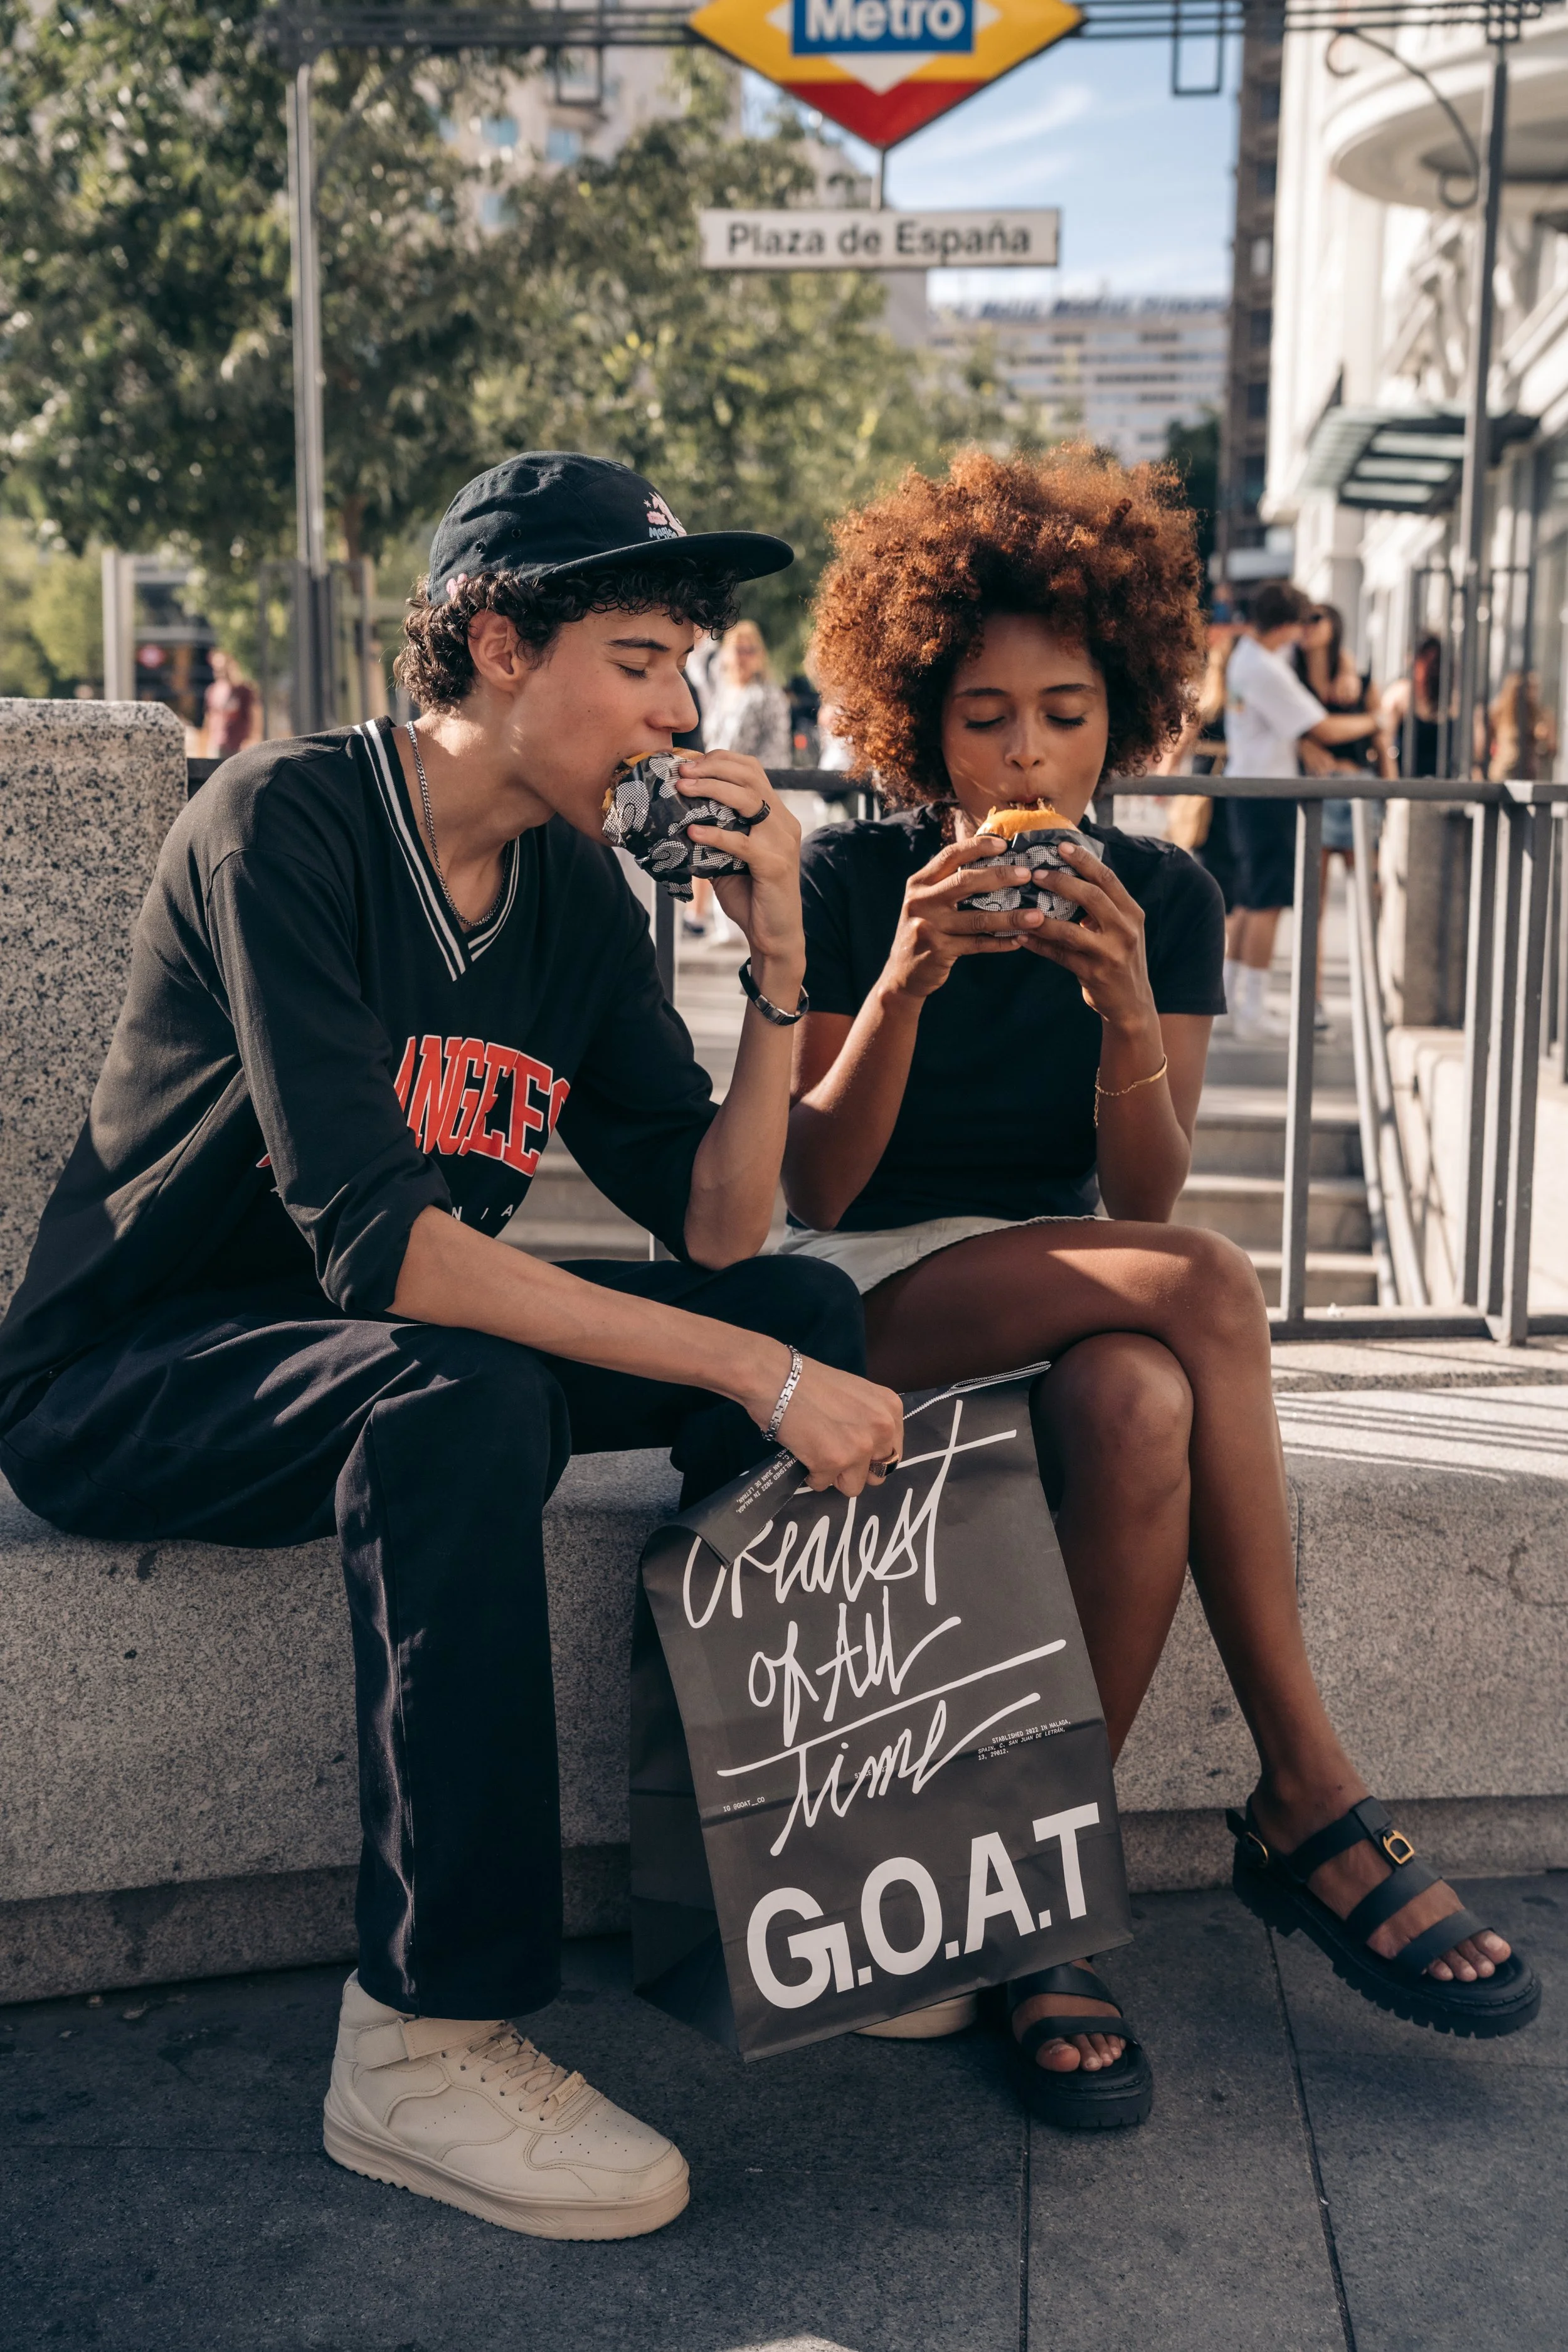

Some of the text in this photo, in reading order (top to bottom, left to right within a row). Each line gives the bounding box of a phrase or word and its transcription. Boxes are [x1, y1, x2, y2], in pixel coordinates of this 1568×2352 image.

[805, 0, 967, 41] Metro
[727, 218, 1030, 260] Plaza de España
[761, 1469, 773, 1481] JUAN
[773, 1461, 783, 1471] SAN
[773, 1456, 798, 1481] TABLISHED
[755, 1480, 762, 1488] DE
[762, 1479, 773, 1491] 2022
[748, 1586, 961, 1747] of All
[992, 1730, 1024, 1744] STABLISHED
[1025, 1727, 1039, 1735] 2022
[1049, 1719, 1071, 1729] MALAGA,
[1045, 1727, 1065, 1737] LETRÁN,
[717, 1639, 1067, 1857] Time
[747, 1802, 1100, 2009] G.O.A.T
